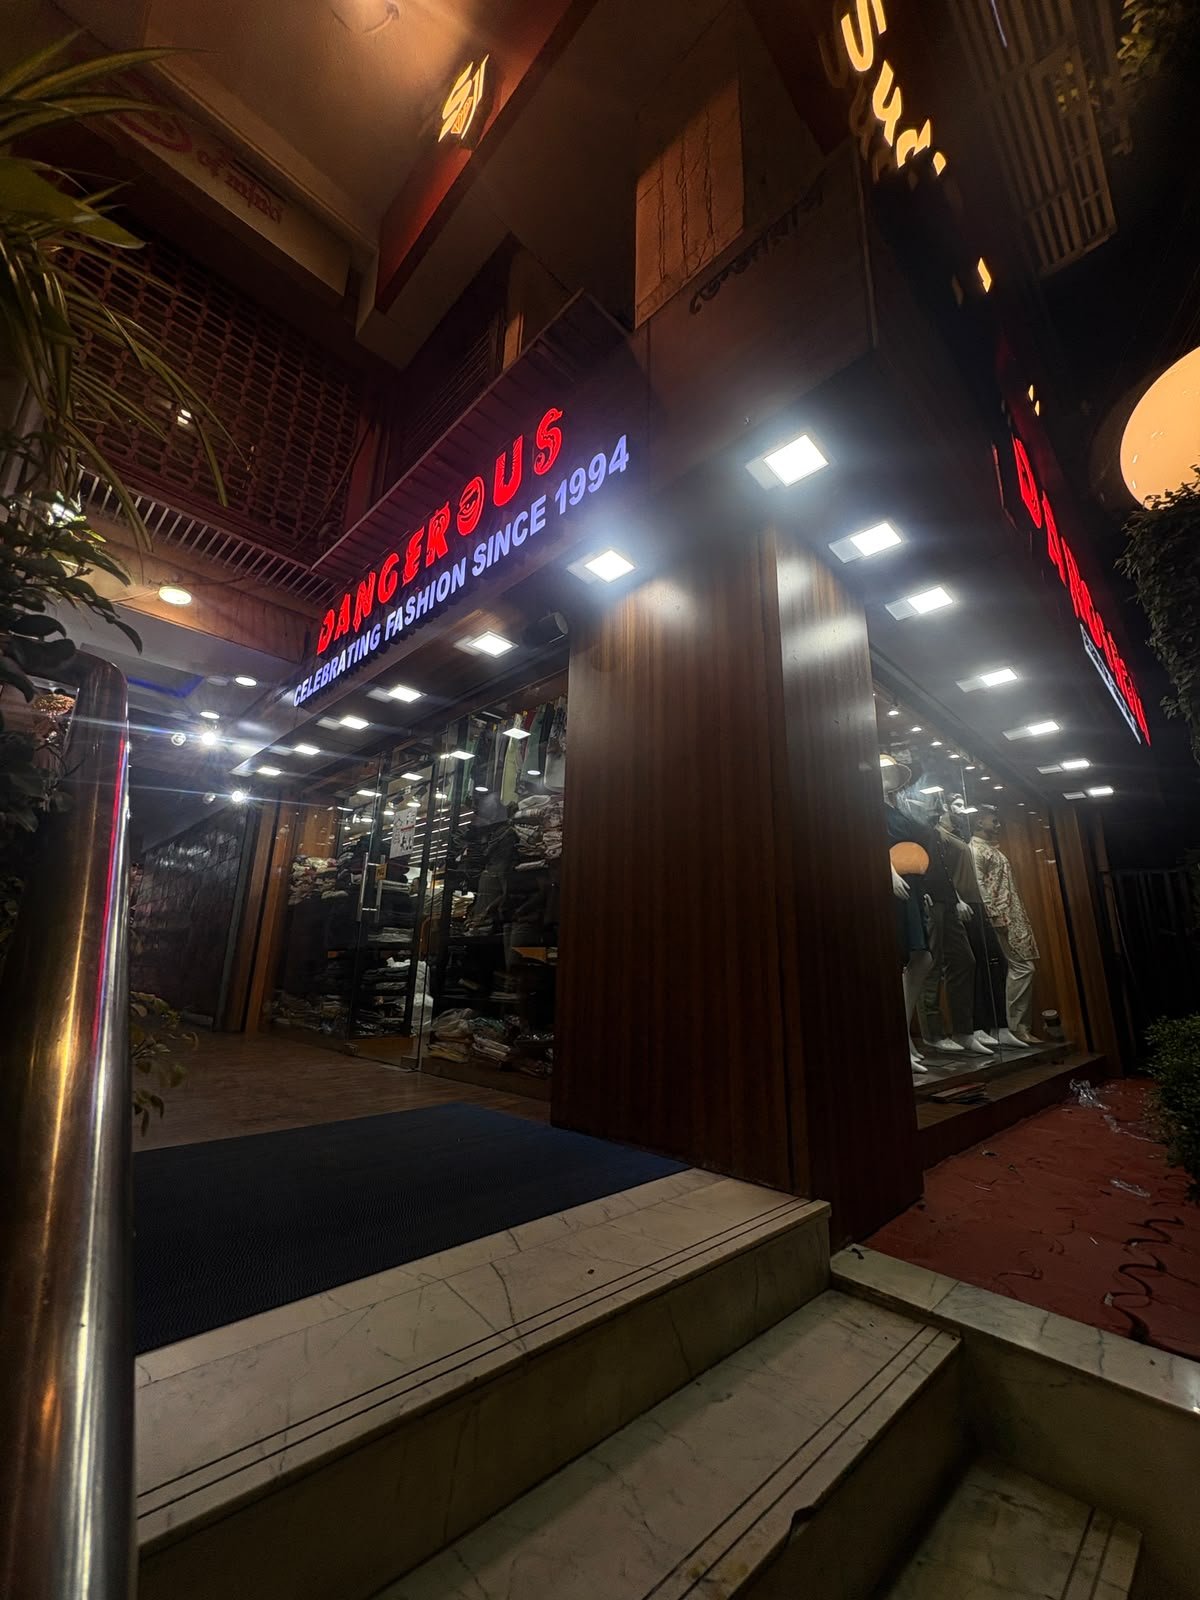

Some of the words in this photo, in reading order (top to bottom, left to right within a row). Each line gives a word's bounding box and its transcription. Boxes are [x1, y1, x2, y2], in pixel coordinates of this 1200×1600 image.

[293, 623, 381, 707] CELEBRATING
[384, 557, 467, 642] FASHION
[471, 494, 547, 577] SINCE
[554, 434, 630, 516] 1994
[316, 407, 563, 656] DANGEROUS
